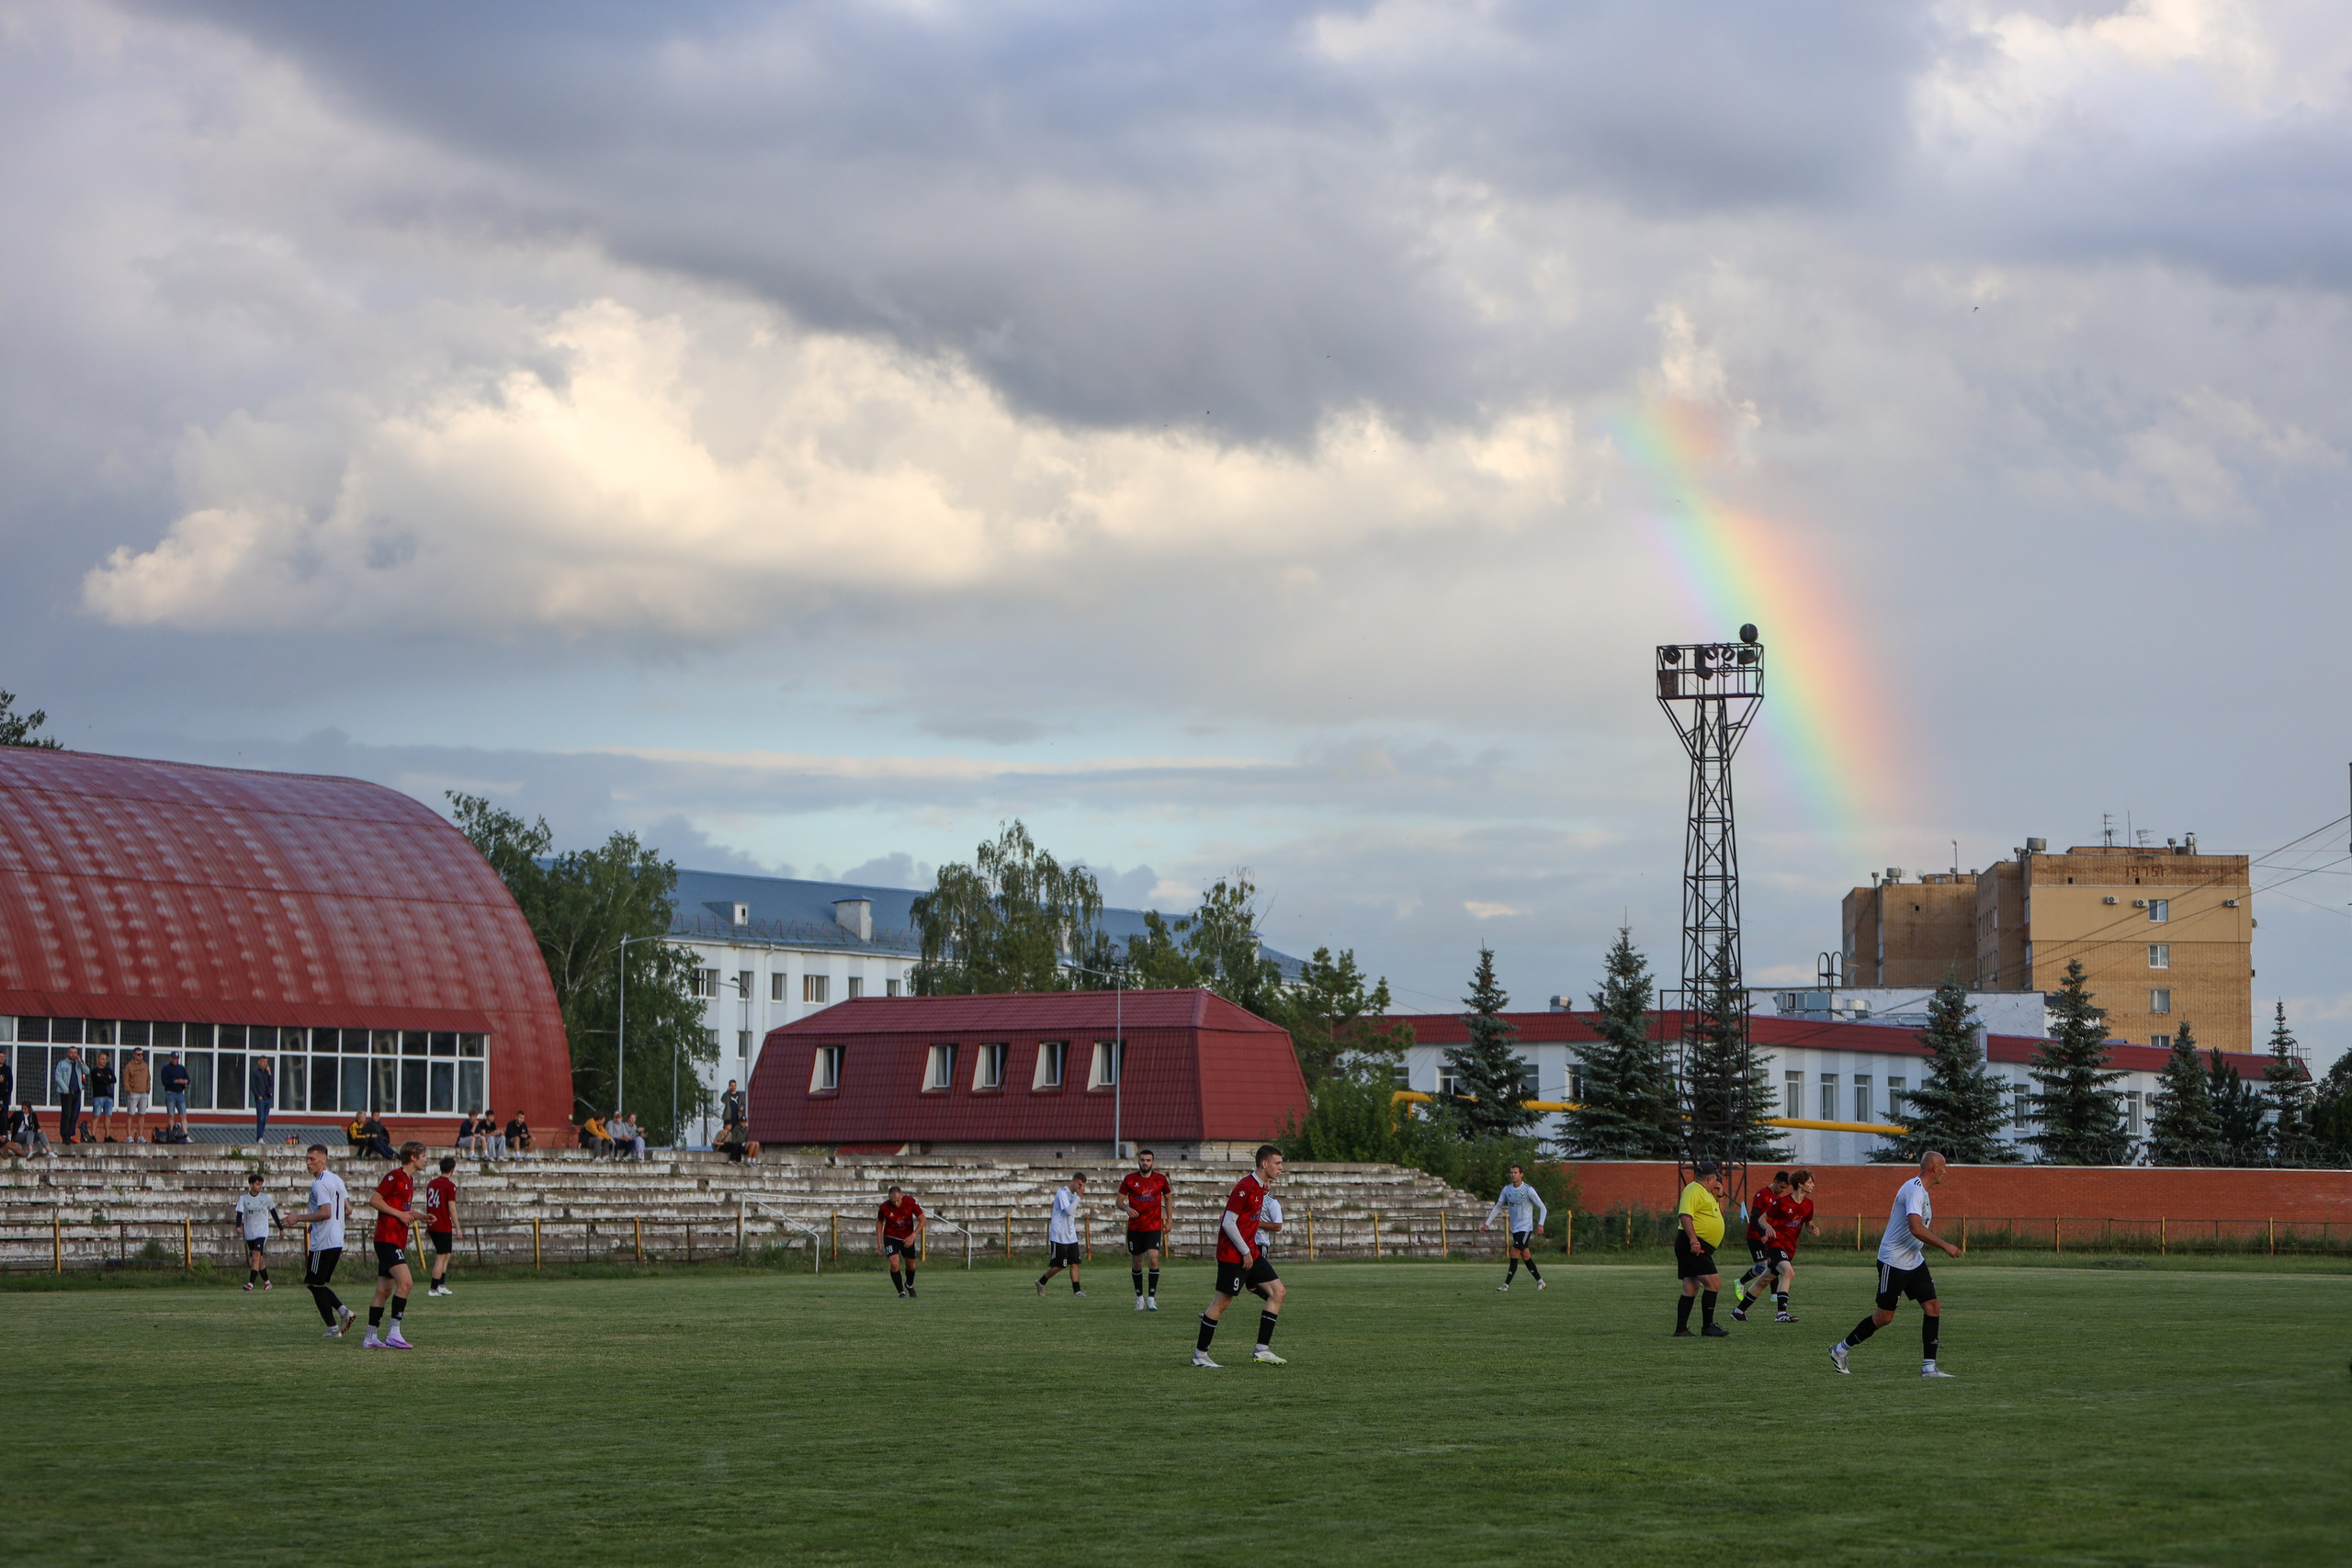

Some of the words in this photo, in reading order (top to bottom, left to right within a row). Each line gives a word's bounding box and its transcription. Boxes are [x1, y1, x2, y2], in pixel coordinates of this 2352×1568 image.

[427, 1188, 440, 1208] 24
[335, 1190, 340, 1220] 1
[1756, 1249, 1765, 1259] 11
[1780, 1250, 1790, 1260] 8
[1062, 1258, 1068, 1267] 8
[1232, 1277, 1240, 1292] 9
